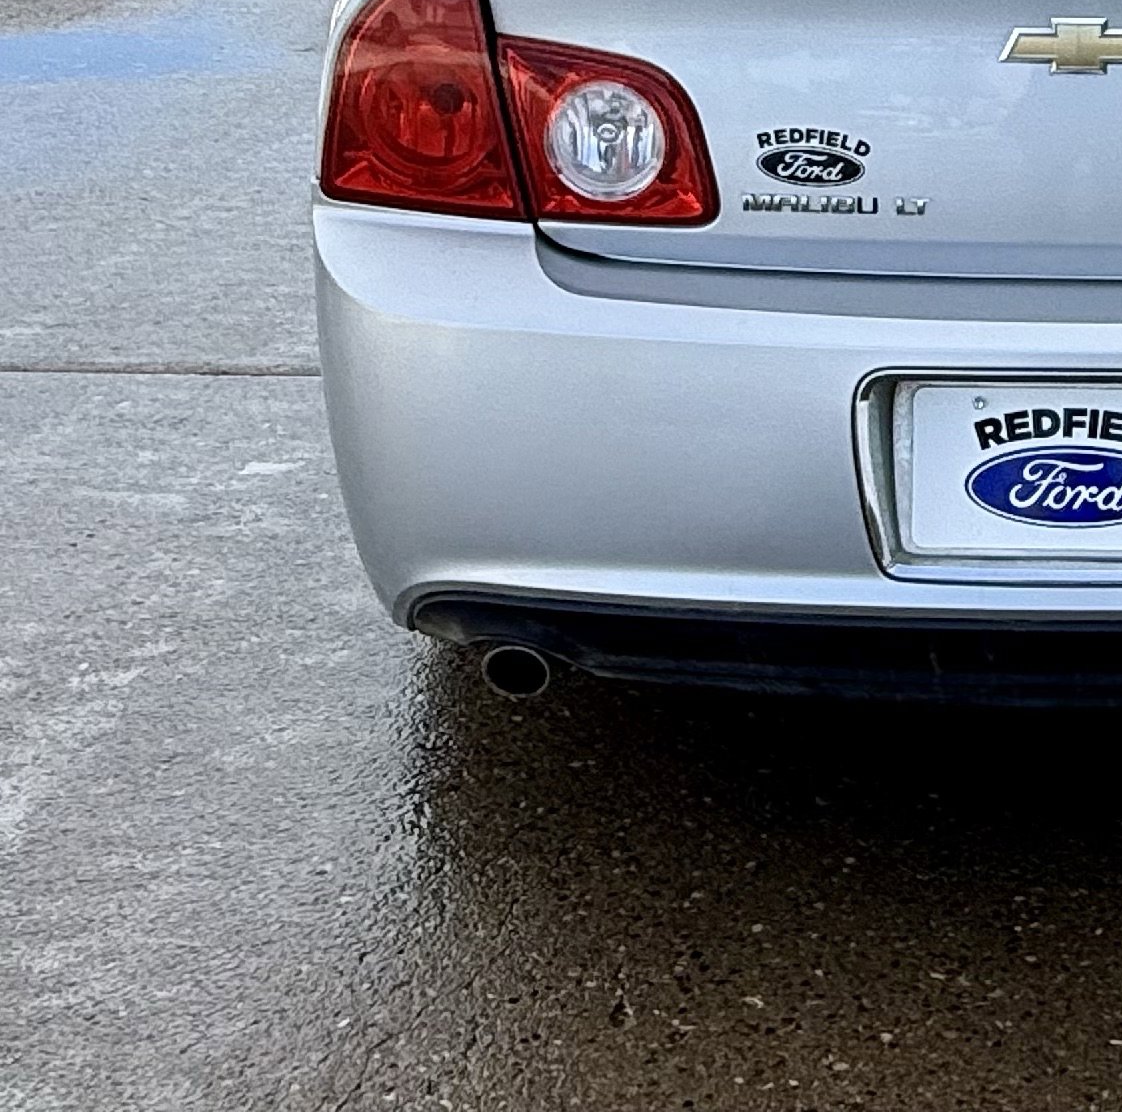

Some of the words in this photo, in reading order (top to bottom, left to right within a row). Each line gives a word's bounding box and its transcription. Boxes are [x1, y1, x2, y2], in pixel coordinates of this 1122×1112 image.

[756, 127, 871, 157] REDFIELD
[777, 151, 844, 181] Ford
[742, 192, 879, 215] MALIBU
[895, 195, 930, 216] LT
